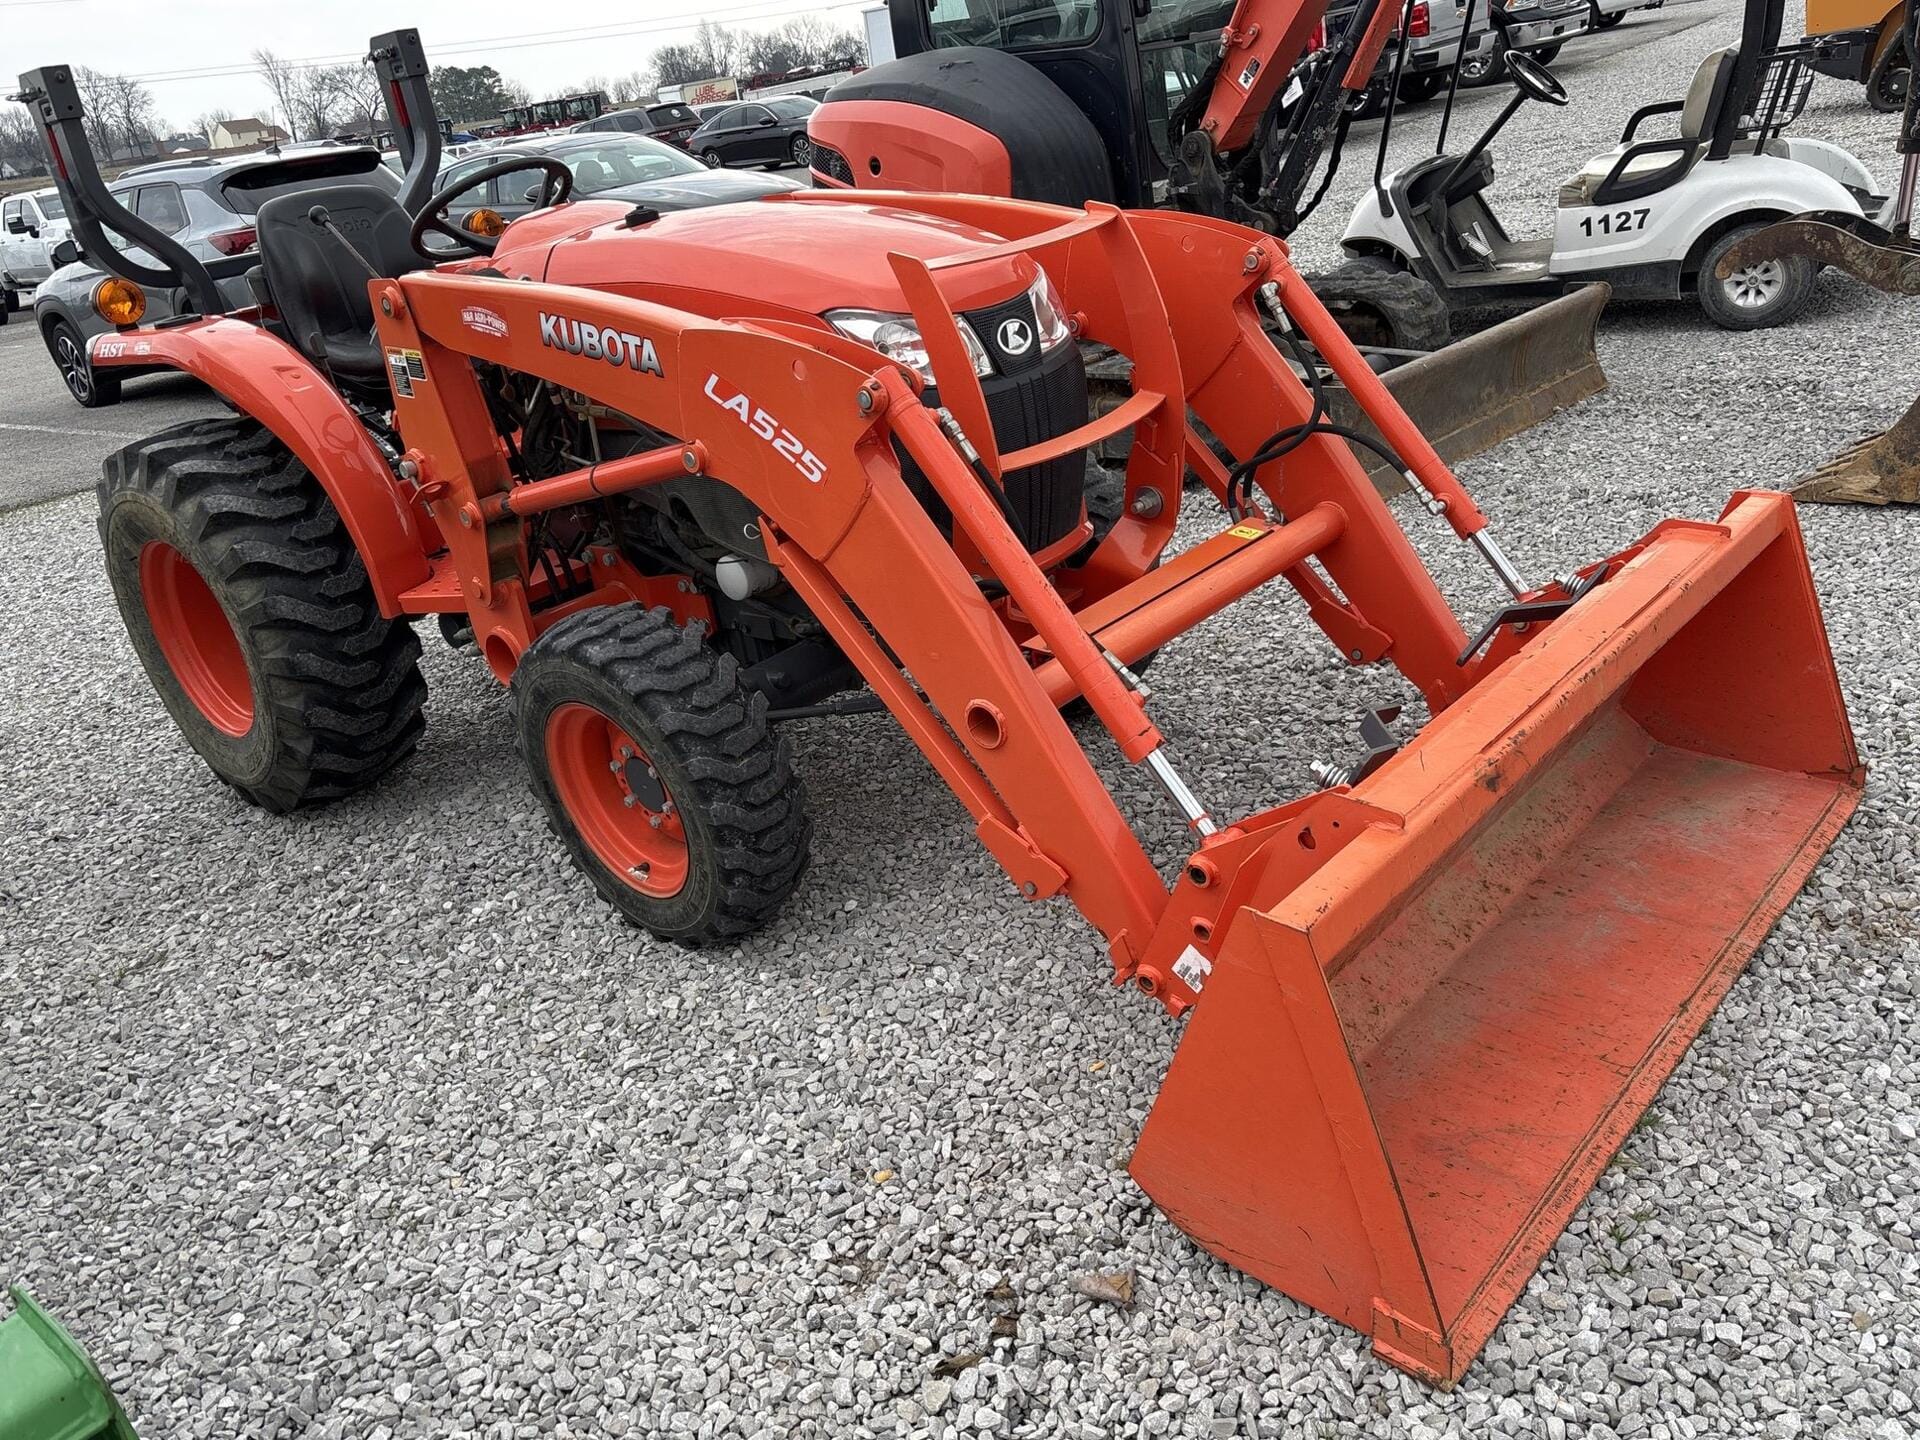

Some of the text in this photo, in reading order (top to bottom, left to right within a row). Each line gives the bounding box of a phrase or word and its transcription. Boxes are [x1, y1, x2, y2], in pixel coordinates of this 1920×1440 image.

[691, 91, 727, 105] EXPRESS
[695, 84, 715, 97] LUBE
[1579, 207, 1651, 238] 1127
[99, 342, 127, 358] HST
[538, 310, 665, 379] KUBOTA
[703, 372, 828, 484] LA525
